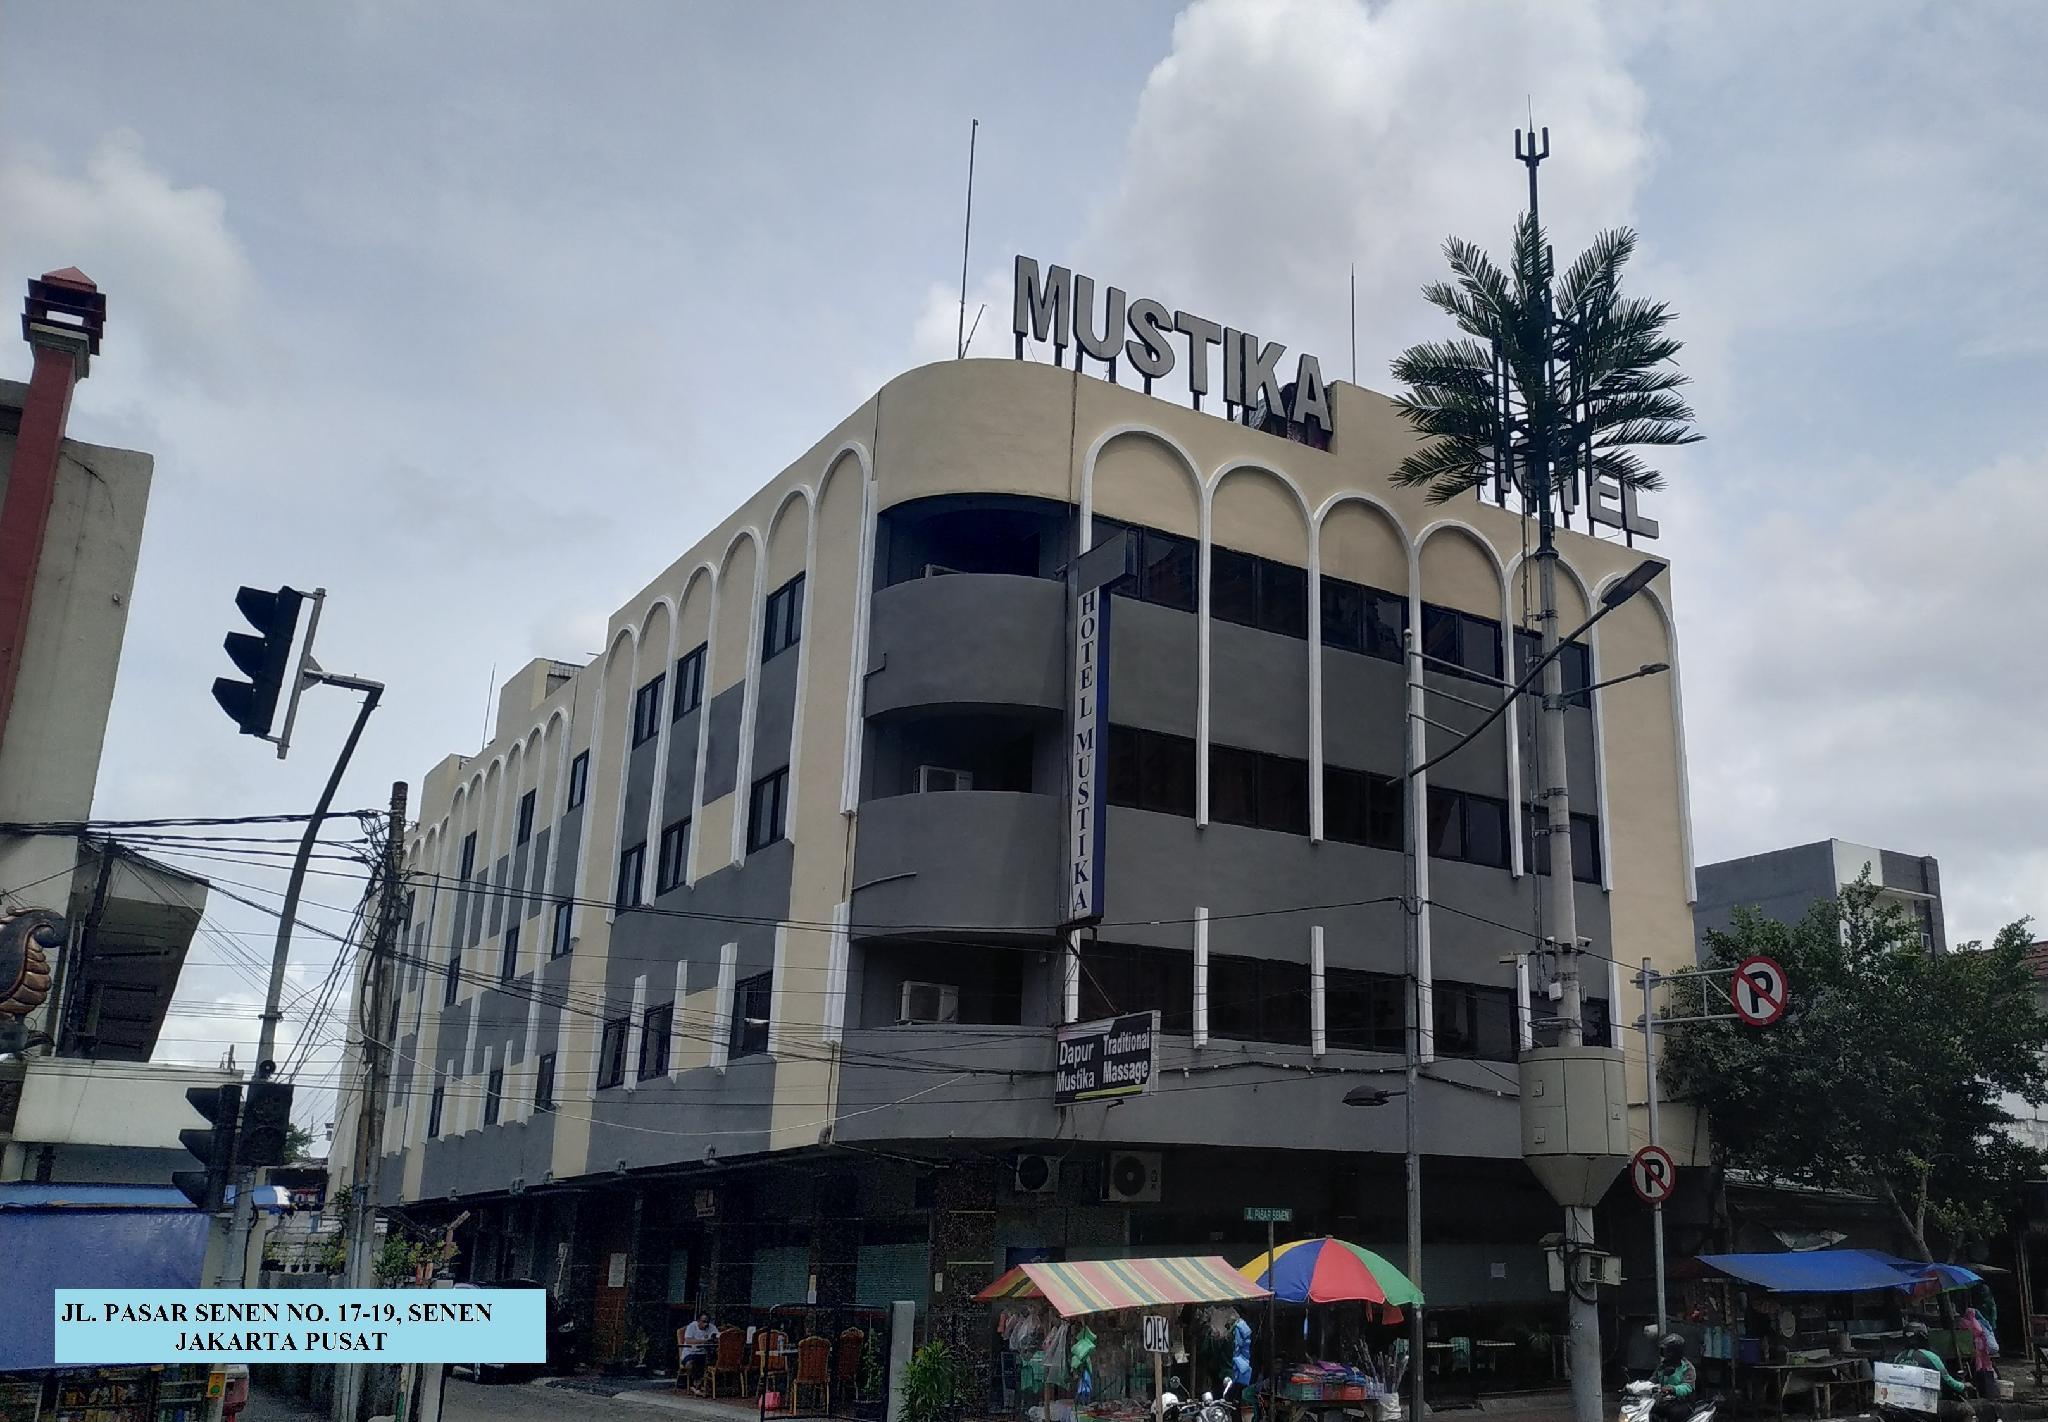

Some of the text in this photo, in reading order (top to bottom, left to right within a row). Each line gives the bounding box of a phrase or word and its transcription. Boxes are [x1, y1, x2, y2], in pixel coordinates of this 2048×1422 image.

[1015, 254, 1333, 435] MUSTIKA
[1074, 590, 1096, 912] HOTEL MUSTIKA
[1749, 971, 1774, 1014] P
[1059, 1042, 1095, 1069] Dapur
[1103, 1027, 1150, 1056] Traditional
[1056, 1068, 1095, 1092] Mustika
[1103, 1060, 1148, 1085] Massage
[1645, 1159, 1665, 1194] P
